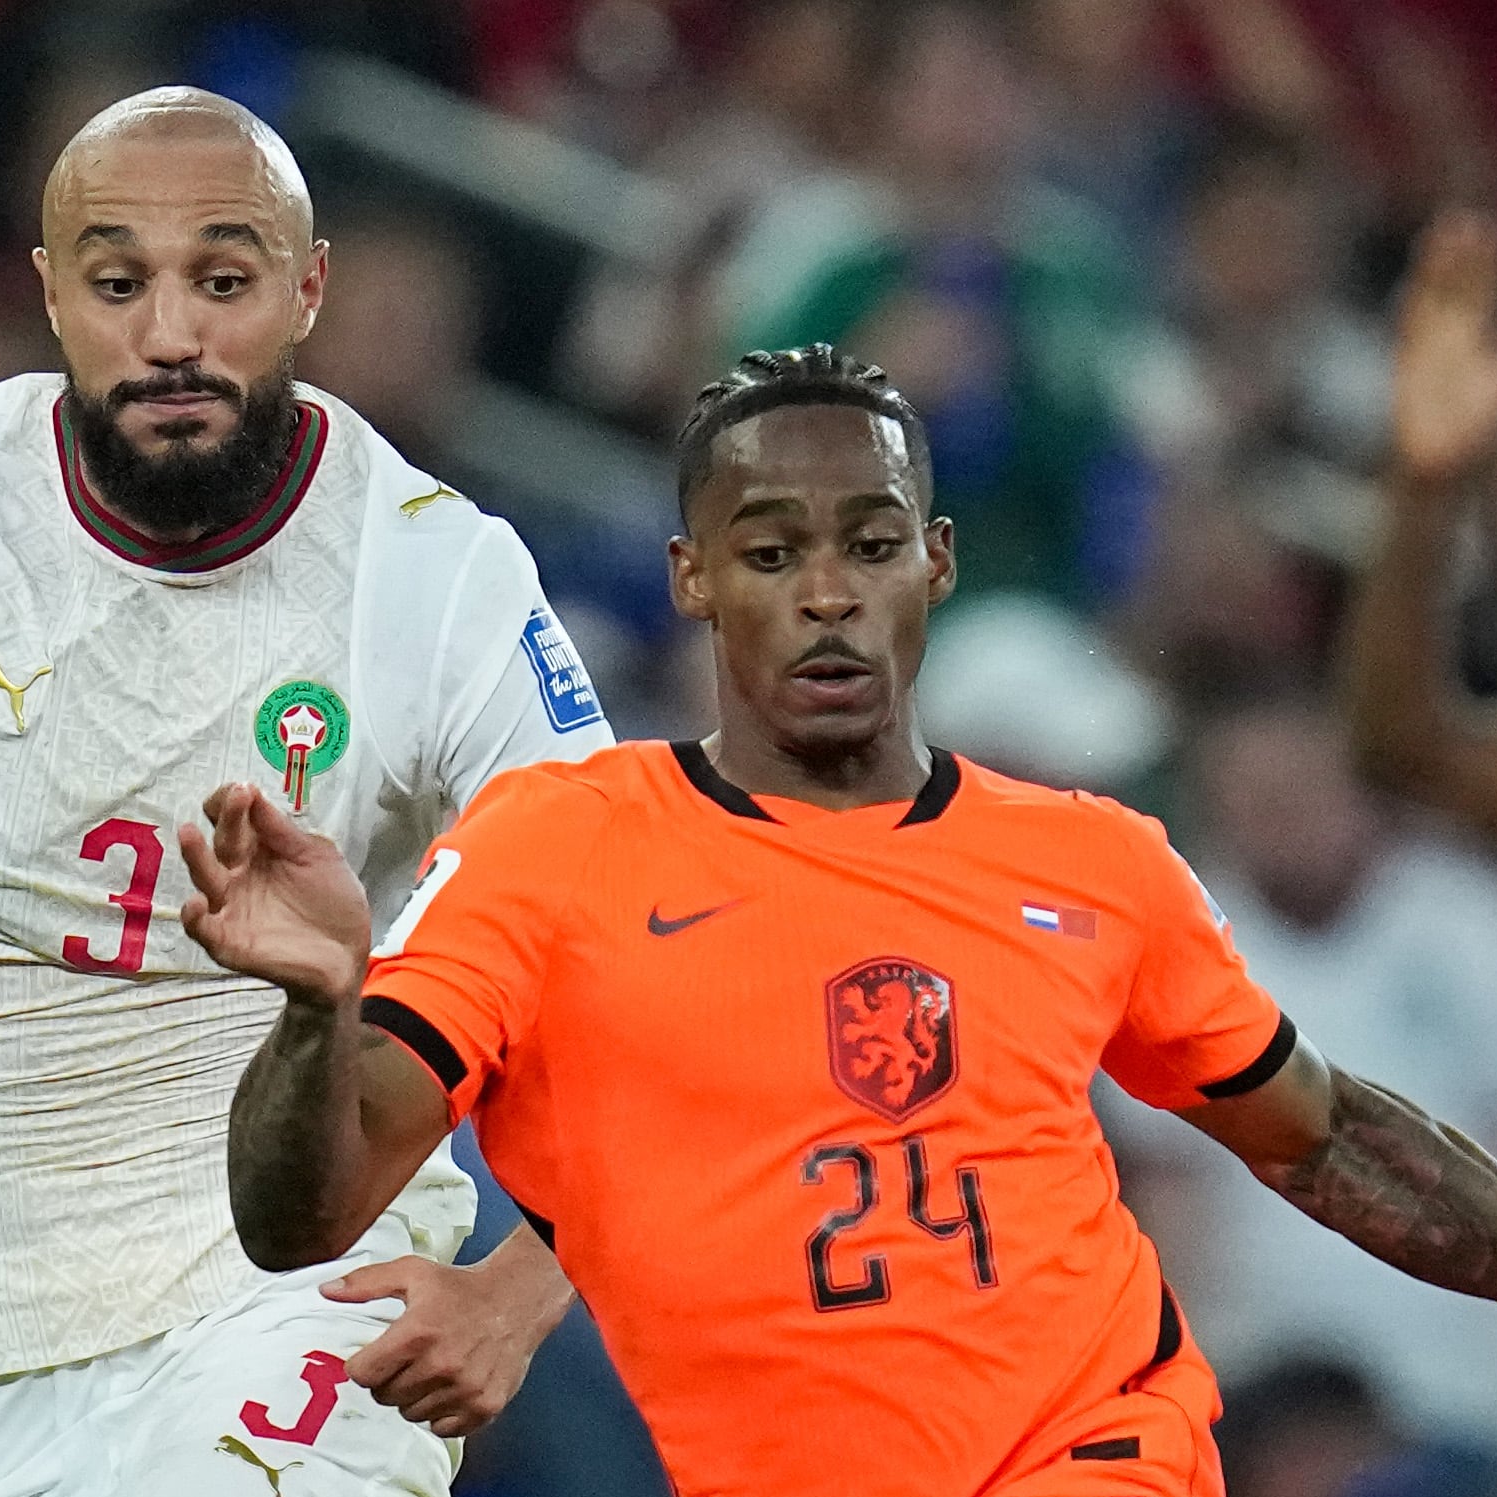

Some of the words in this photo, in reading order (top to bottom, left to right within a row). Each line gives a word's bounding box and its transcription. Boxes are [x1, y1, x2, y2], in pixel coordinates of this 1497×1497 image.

[549, 673, 572, 697] the
[61, 818, 164, 975] 3
[799, 1134, 1000, 1313] 24
[239, 1349, 350, 1446] 3
